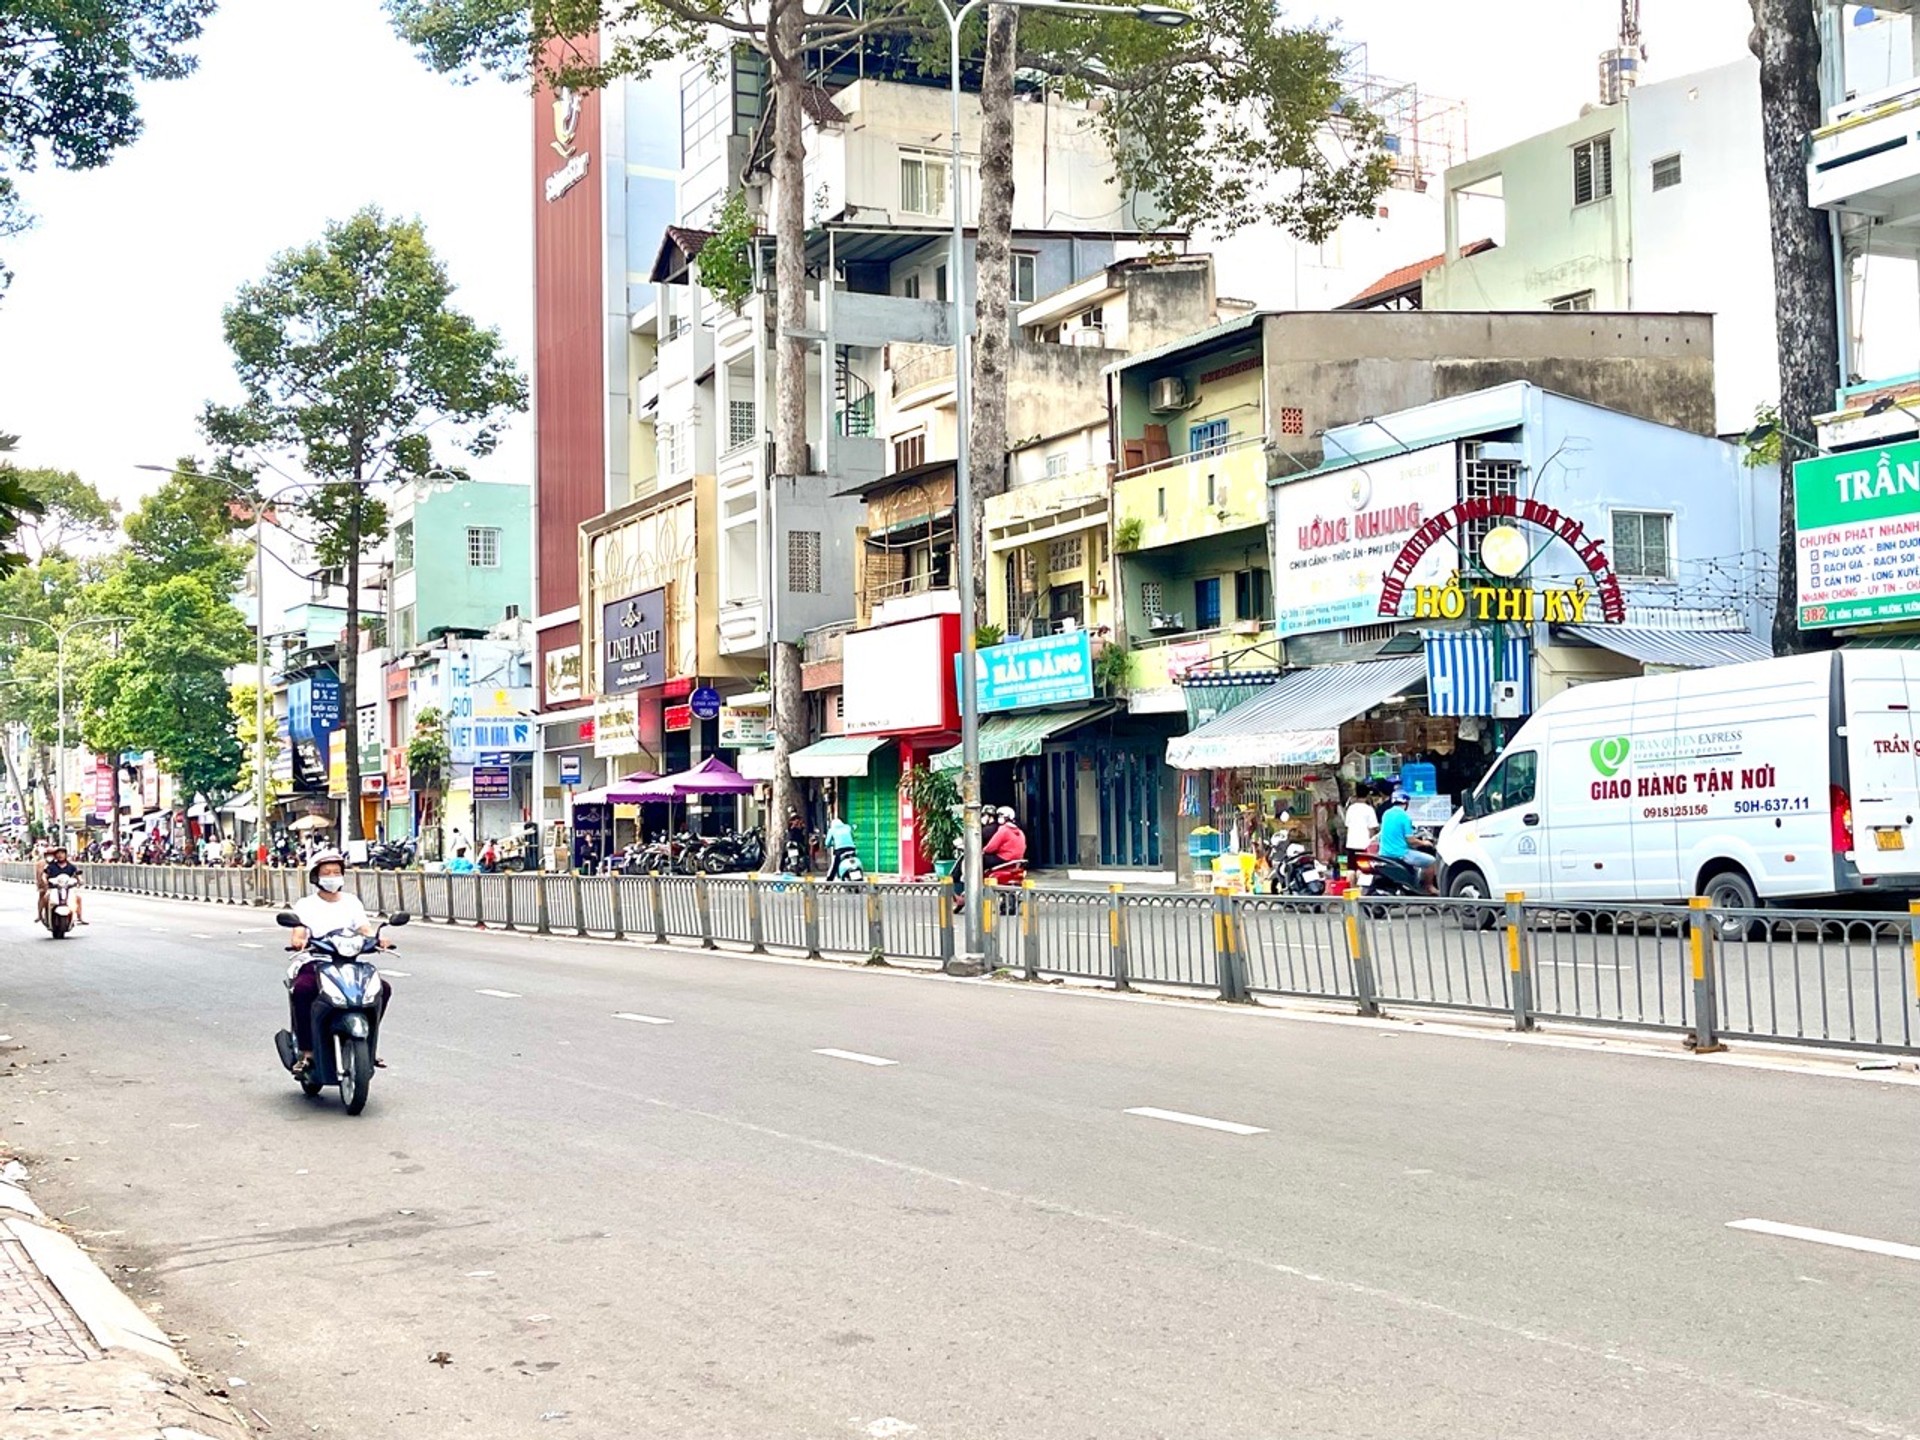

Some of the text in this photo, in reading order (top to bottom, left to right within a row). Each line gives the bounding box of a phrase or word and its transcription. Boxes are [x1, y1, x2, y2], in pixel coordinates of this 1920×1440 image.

[1834, 451, 1920, 503] TRẦN
[1355, 502, 1421, 540] NHUNG
[1522, 498, 1560, 531] HOA
[1880, 521, 1919, 536] NHANH
[1414, 569, 1592, 629] HỒ THỊ KỶ
[1802, 606, 1827, 623] 382
[607, 629, 658, 664] LINH ANH
[1698, 730, 1743, 746] EXPRESS
[1591, 778, 1631, 801] GIAO
[1638, 773, 1687, 798] HÀNG
[1694, 767, 1733, 797] TẬN
[1643, 797, 1809, 818] 0918125156 50H-637.11
